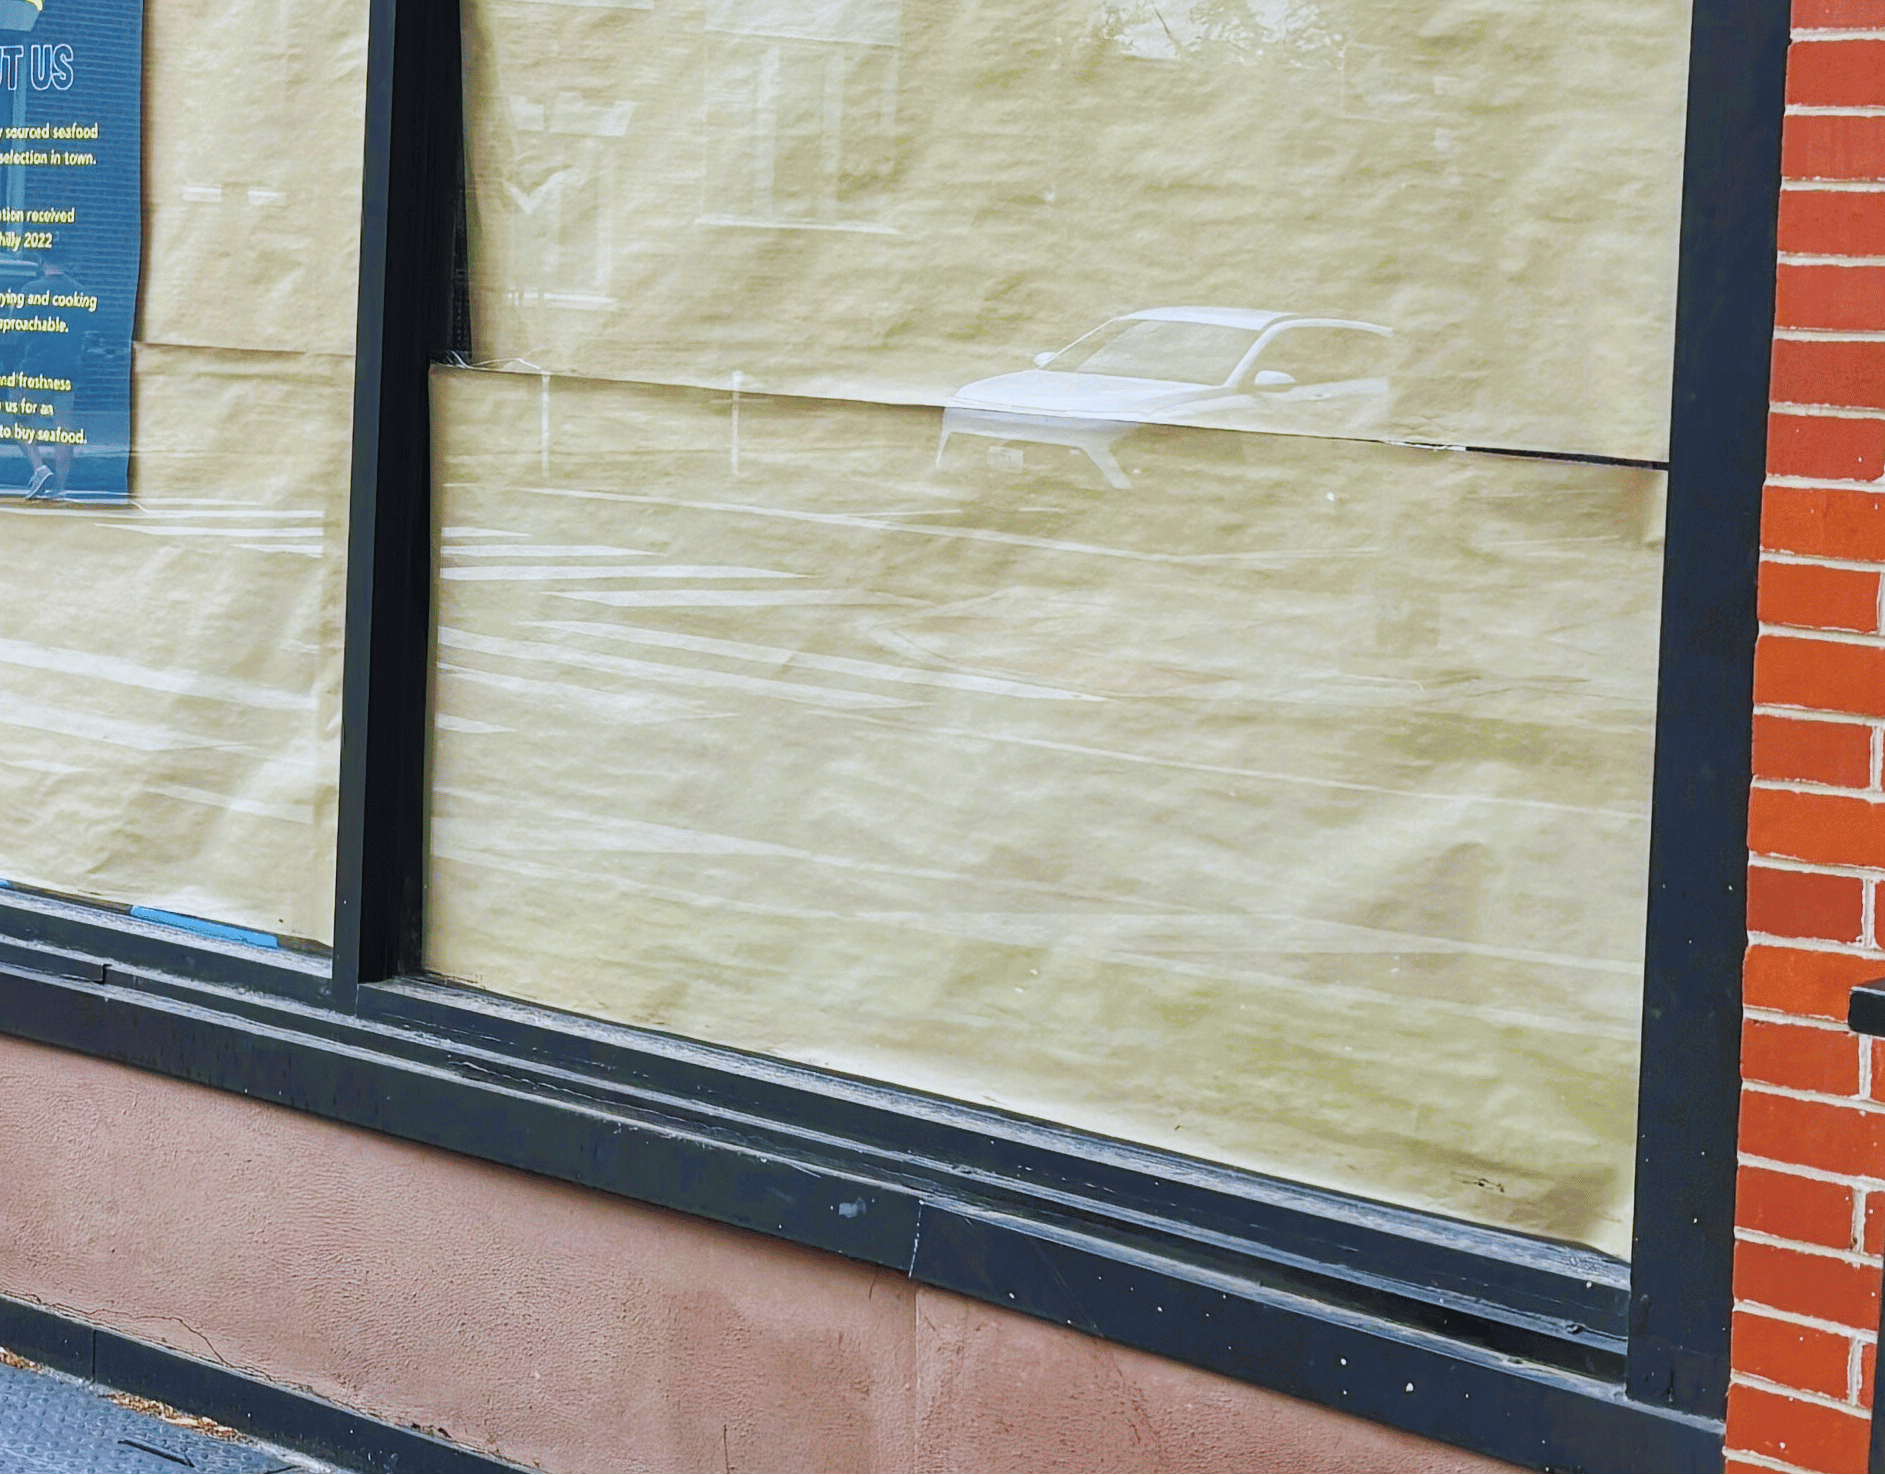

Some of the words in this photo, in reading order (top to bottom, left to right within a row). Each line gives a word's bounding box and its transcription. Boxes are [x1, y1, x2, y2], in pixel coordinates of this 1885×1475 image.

[31, 43, 74, 91] US
[5, 123, 49, 139] sourced
[53, 123, 98, 139] seafood
[50, 150, 61, 164] in
[65, 150, 96, 165] town.
[27, 207, 75, 223] received
[24, 233, 53, 248] 2022
[28, 290, 49, 305] and
[52, 292, 97, 312] cooking
[18, 372, 72, 391] freshness
[5, 402, 18, 413] us
[20, 398, 37, 414] for
[40, 403, 54, 415] an
[0, 425, 11, 438] to
[15, 423, 35, 444] buy
[38, 427, 87, 444] seafood.
